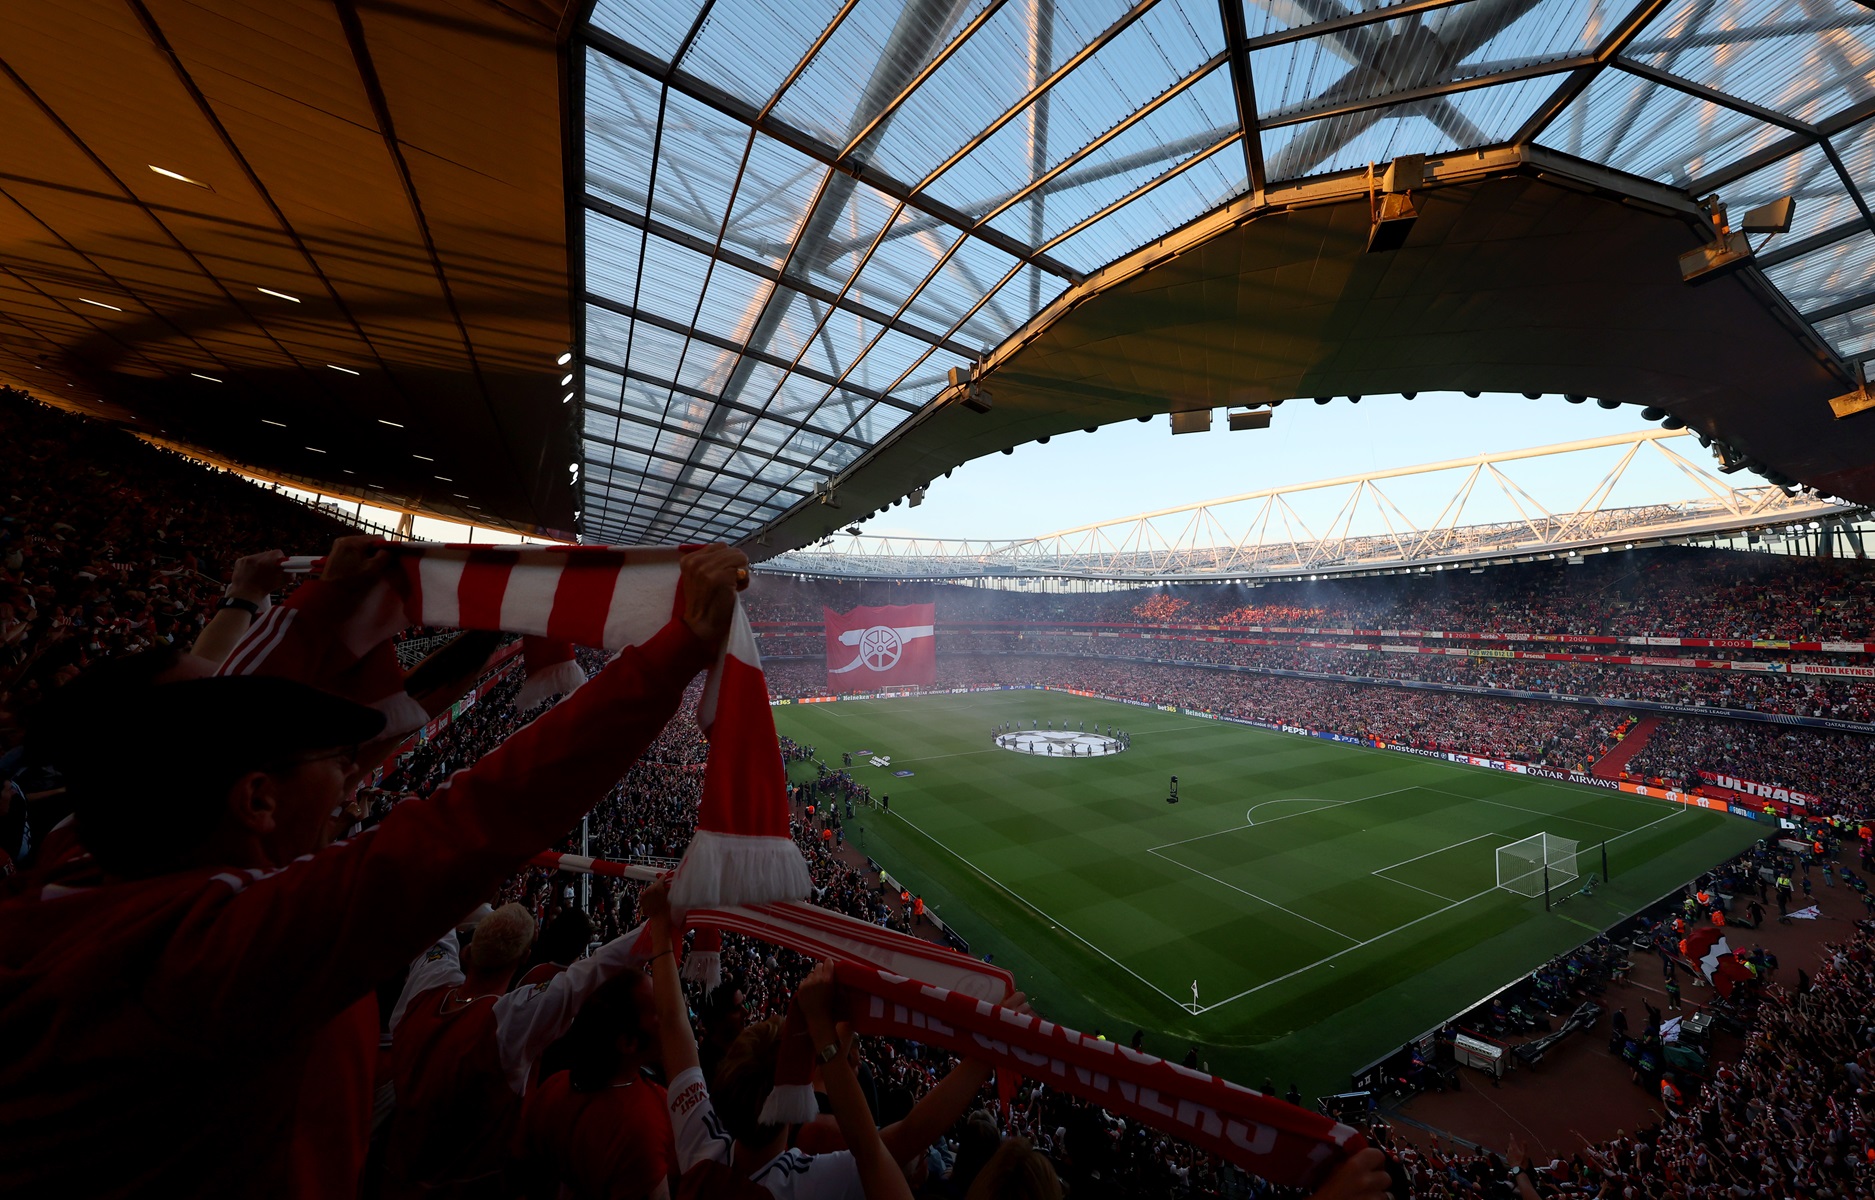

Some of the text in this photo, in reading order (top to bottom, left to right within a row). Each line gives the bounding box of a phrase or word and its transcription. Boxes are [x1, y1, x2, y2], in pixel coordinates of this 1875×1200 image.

[1805, 666, 1873, 676] MILTON KEYNES
[1127, 699, 1149, 707] crypto.com
[1157, 704, 1177, 713] bet365
[1185, 709, 1213, 720] Heineken
[1282, 725, 1308, 736] PEPSI
[1825, 721, 1875, 732] QATAR AIRWAYS
[1342, 735, 1360, 744] PS5
[1387, 743, 1439, 758] mastercard
[1454, 755, 1481, 766] FedEx
[1489, 759, 1518, 772] FedEx
[1527, 767, 1618, 790] QATAR AIRWAYS
[1717, 775, 1806, 807] ULTRAS
[1729, 804, 1756, 821] #FOOTBALL
[671, 1081, 706, 1113] WANDA
[681, 1091, 707, 1116] VISIT
